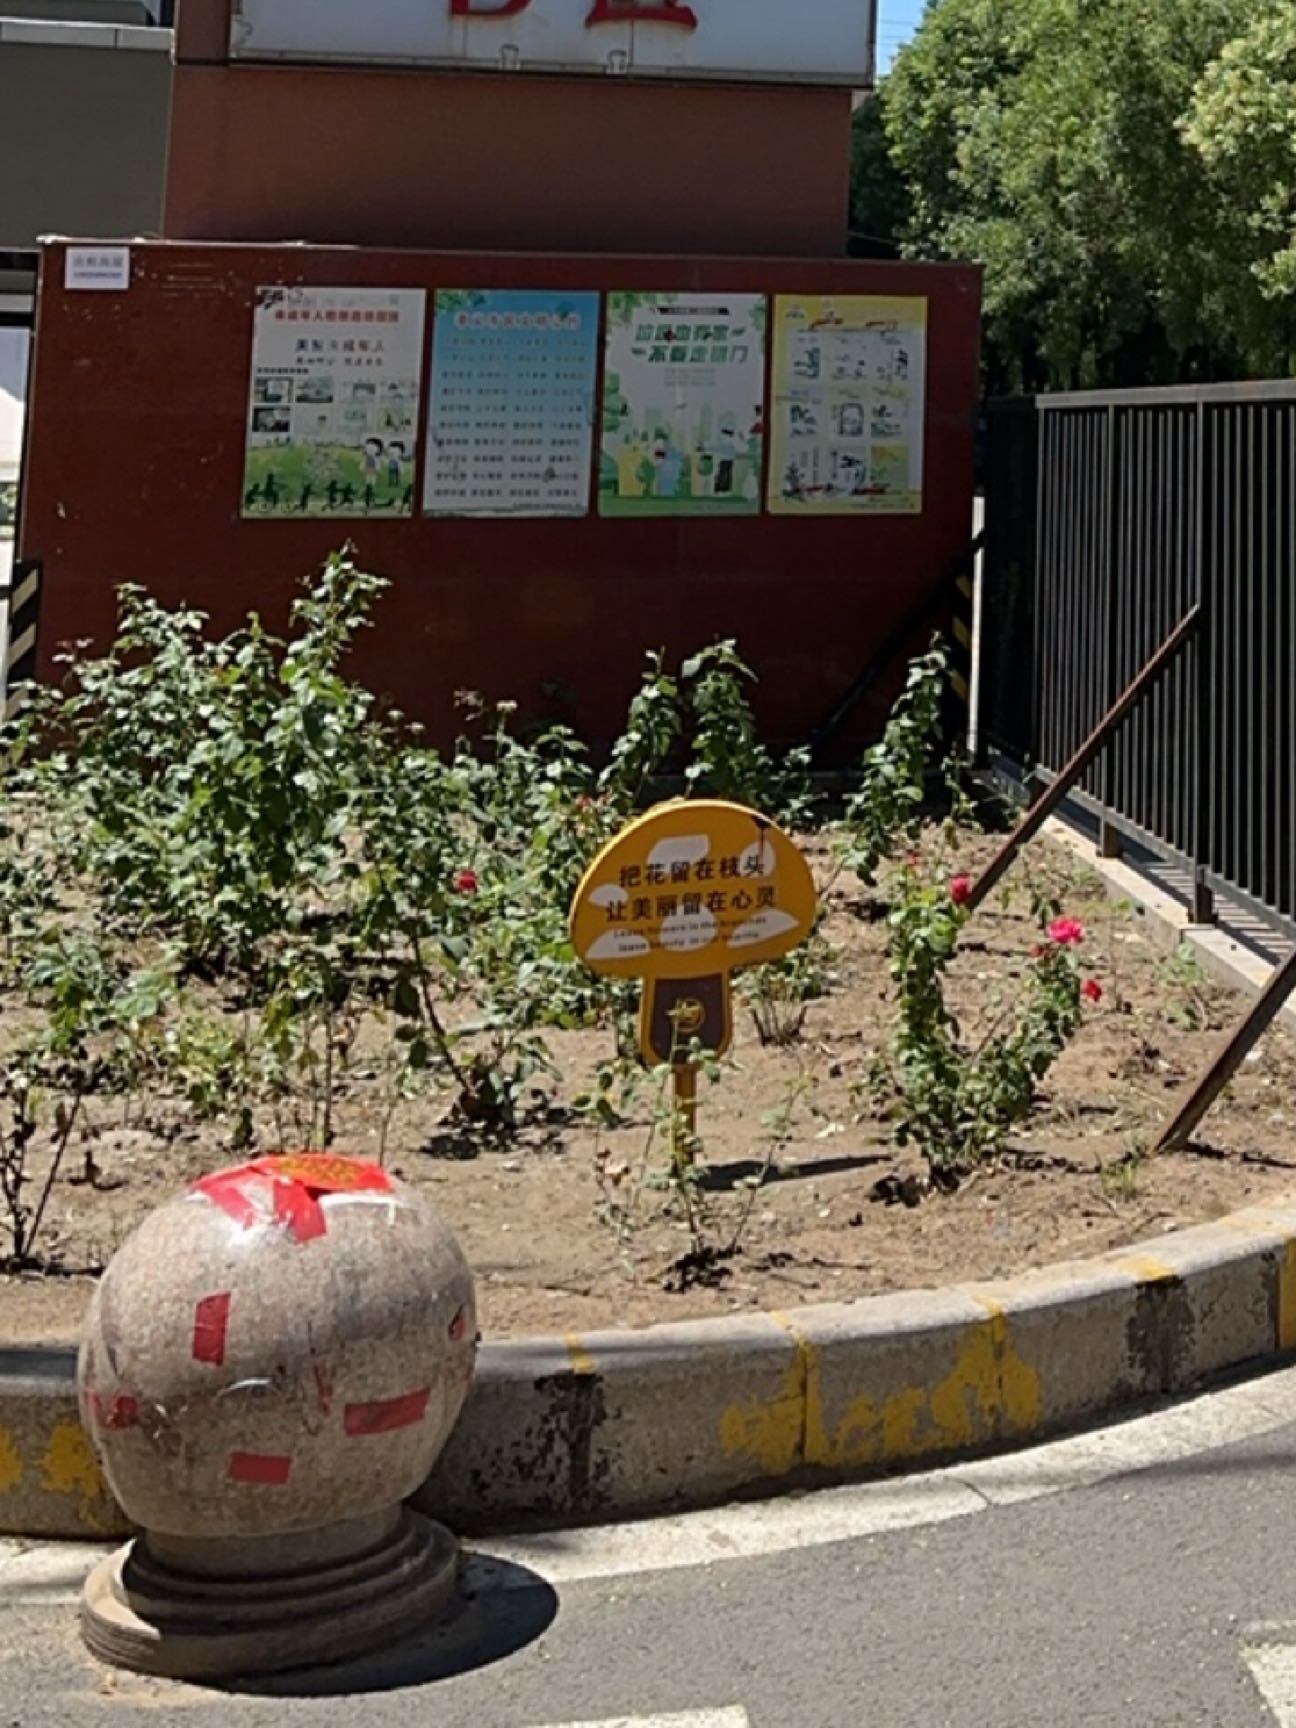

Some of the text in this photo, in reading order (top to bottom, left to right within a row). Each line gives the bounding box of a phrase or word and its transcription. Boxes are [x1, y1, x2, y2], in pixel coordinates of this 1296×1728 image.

[618, 854, 766, 889] 把花留在枝头
[605, 884, 777, 922] 让美丽留在心灵
